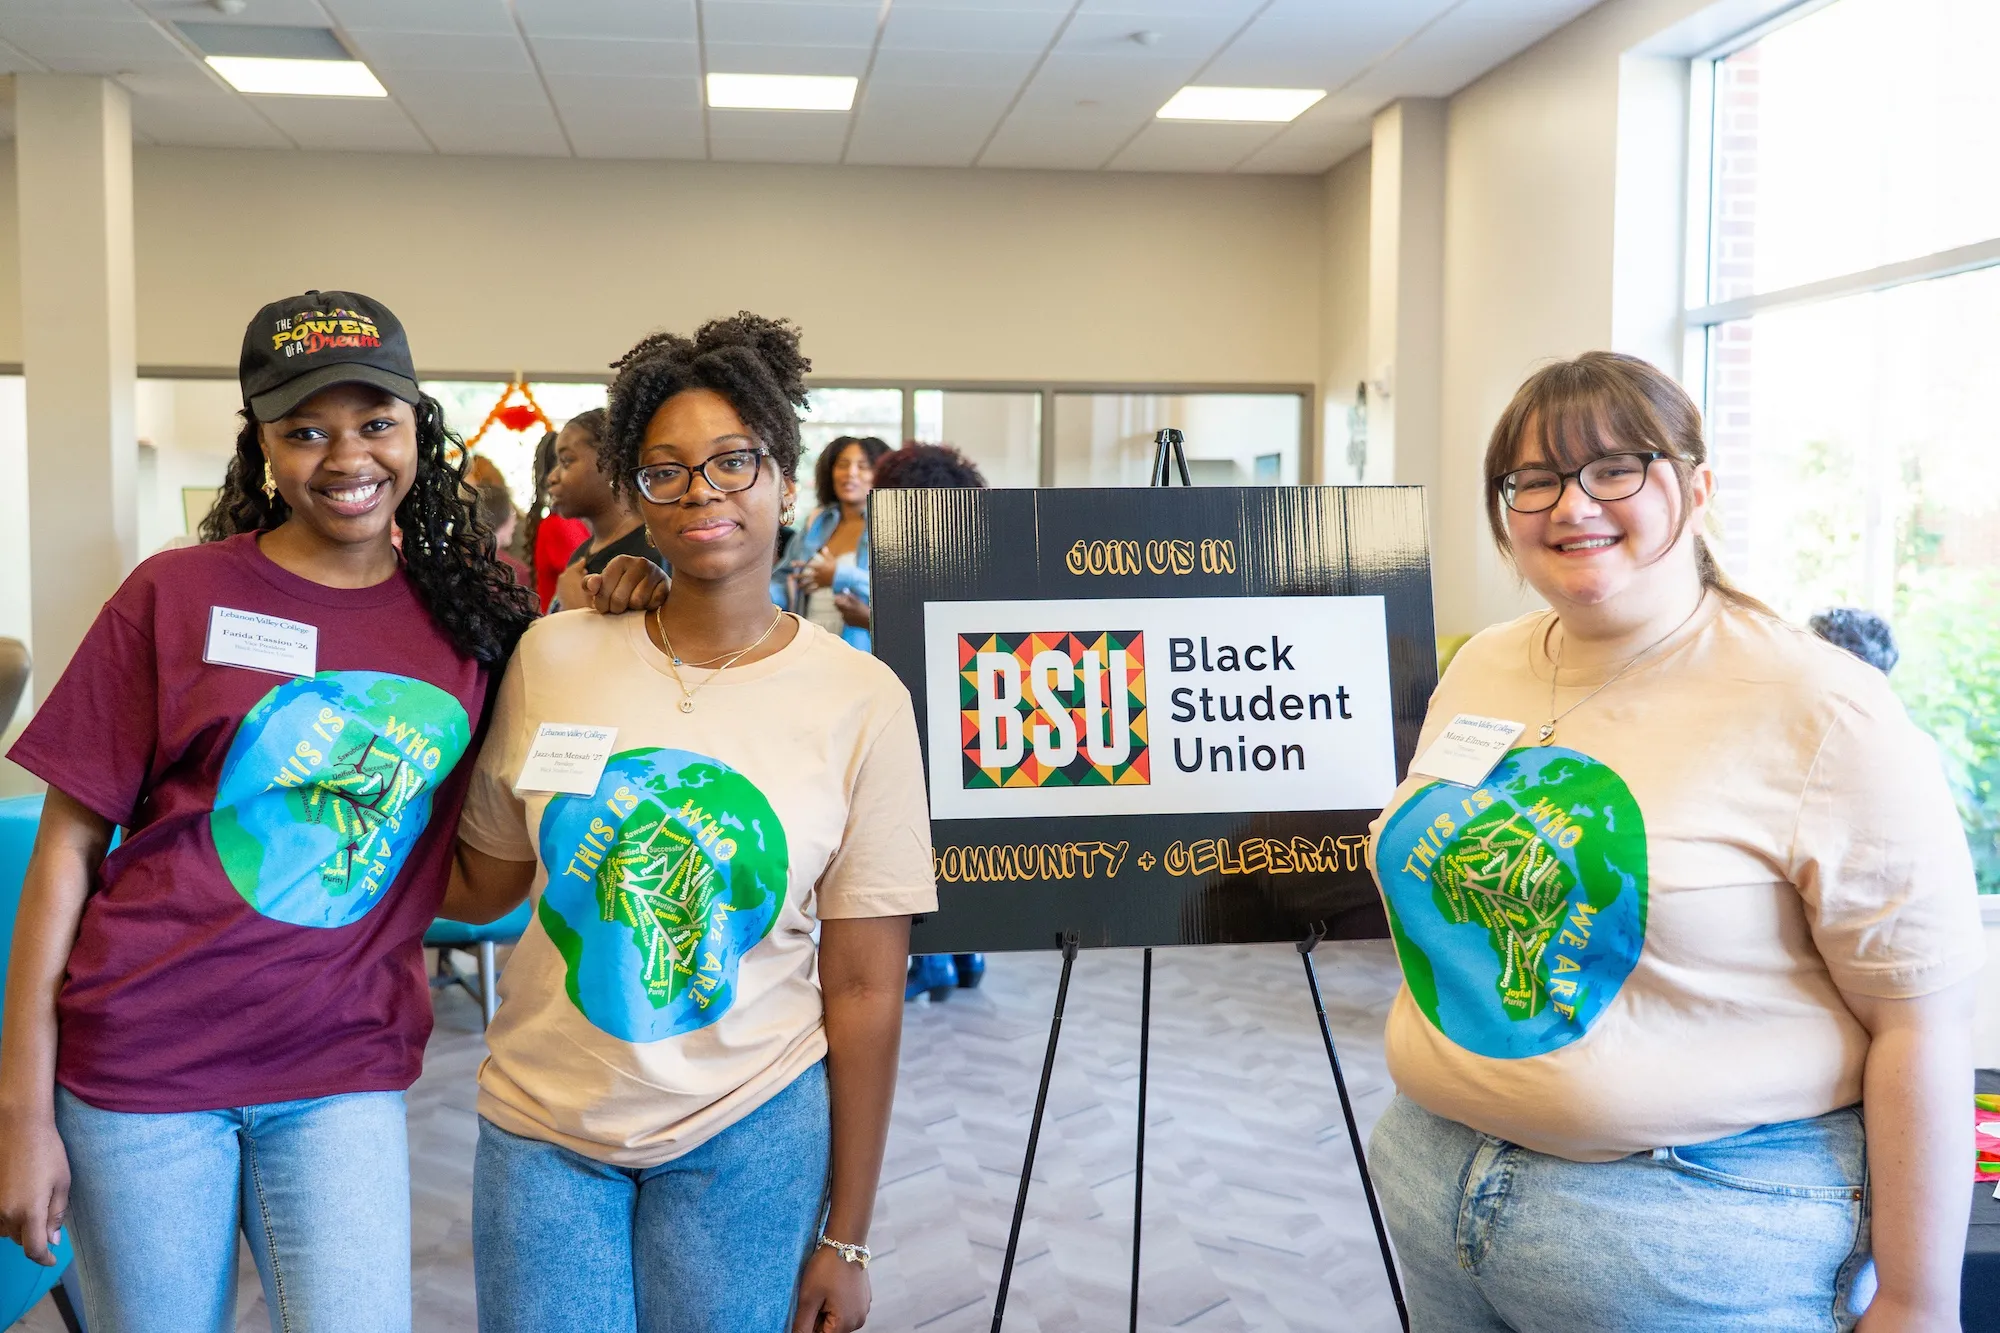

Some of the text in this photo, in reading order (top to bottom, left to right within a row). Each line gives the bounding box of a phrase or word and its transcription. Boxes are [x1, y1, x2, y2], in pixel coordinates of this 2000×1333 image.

[272, 320, 381, 350] POWER
[276, 318, 292, 332] THE
[286, 332, 382, 358] OF A Dream
[1146, 540, 1194, 575] US
[220, 610, 310, 634] Lebanon Valley College
[223, 630, 253, 640] Farida
[1169, 636, 1295, 672] Black
[975, 649, 1132, 769] BSU
[1171, 685, 1352, 722] Student
[540, 728, 608, 740] Lebanon Valley College
[1454, 717, 1516, 735] Lebanon Valley College
[264, 740, 323, 796] HIS
[312, 707, 345, 742] IS
[384, 716, 442, 770] WHO
[1174, 736, 1305, 773] Union
[562, 816, 616, 883] THIS
[606, 786, 639, 819] IS
[624, 820, 659, 840] Sawubona
[660, 826, 692, 846] Powerful
[676, 798, 738, 862] WHO
[1402, 788, 1494, 882] THIS IS
[1466, 818, 1506, 836] Sawubona
[1526, 796, 1584, 848] WHO
[648, 844, 685, 854] Successful
[1456, 852, 1489, 863] Prosperity
[1489, 838, 1524, 849] Successful
[1534, 846, 1545, 868] Truth
[323, 874, 344, 885] Purity
[360, 838, 393, 896] ARE
[1528, 854, 1554, 884] Efficient
[619, 892, 639, 928] Passionate
[648, 896, 678, 914] Beautiful
[1432, 871, 1462, 923] Understanding
[1467, 890, 1492, 929] Passionate
[654, 908, 682, 925] Equality
[674, 963, 693, 976] Peace
[688, 902, 736, 1009] WE ARE
[1500, 930, 1514, 988] Compassionate
[1512, 941, 1526, 990] Harmonious
[1549, 901, 1598, 1022] WE ARE
[648, 988, 666, 997] Purity
[1502, 996, 1528, 1010] Purity
[1505, 988, 1532, 999] Joyful
